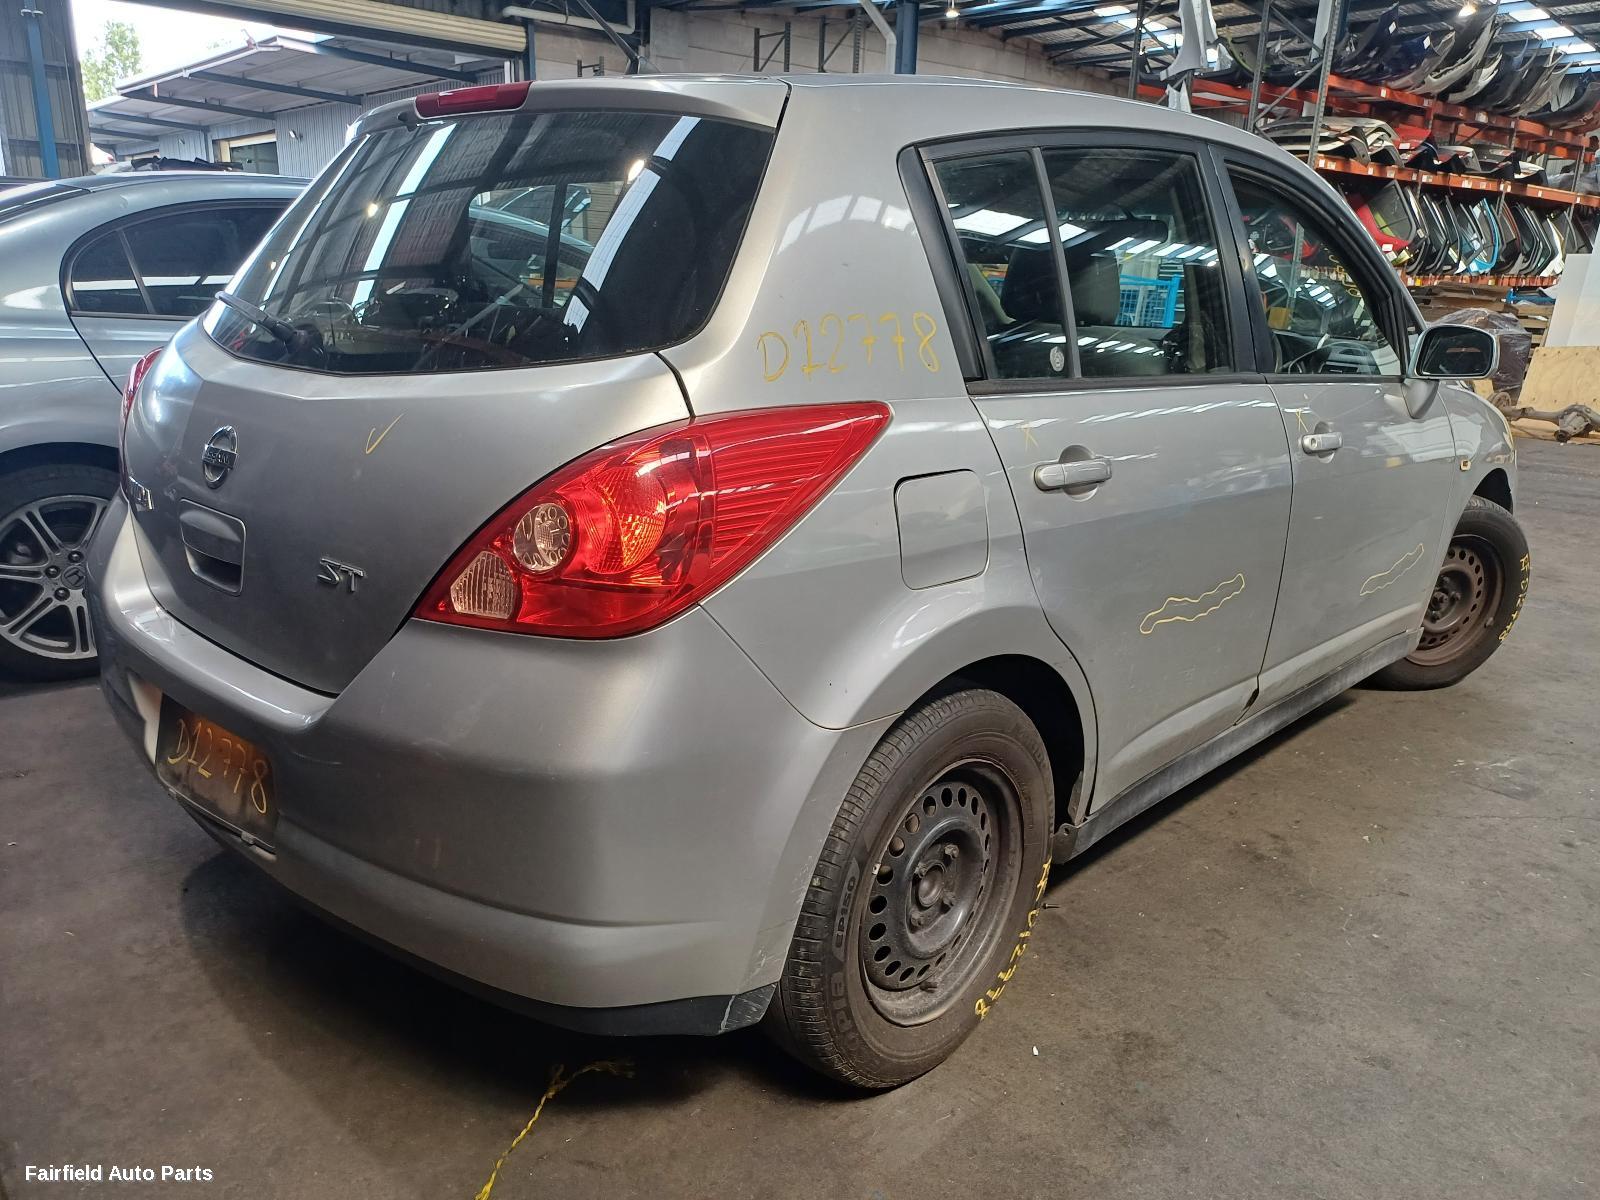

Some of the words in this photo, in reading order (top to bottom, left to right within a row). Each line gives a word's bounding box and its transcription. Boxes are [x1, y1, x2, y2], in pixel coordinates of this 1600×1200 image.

[756, 311, 941, 383] D12778
[317, 557, 366, 592] ST
[167, 718, 267, 814] D12778
[834, 875, 857, 948] EP150
